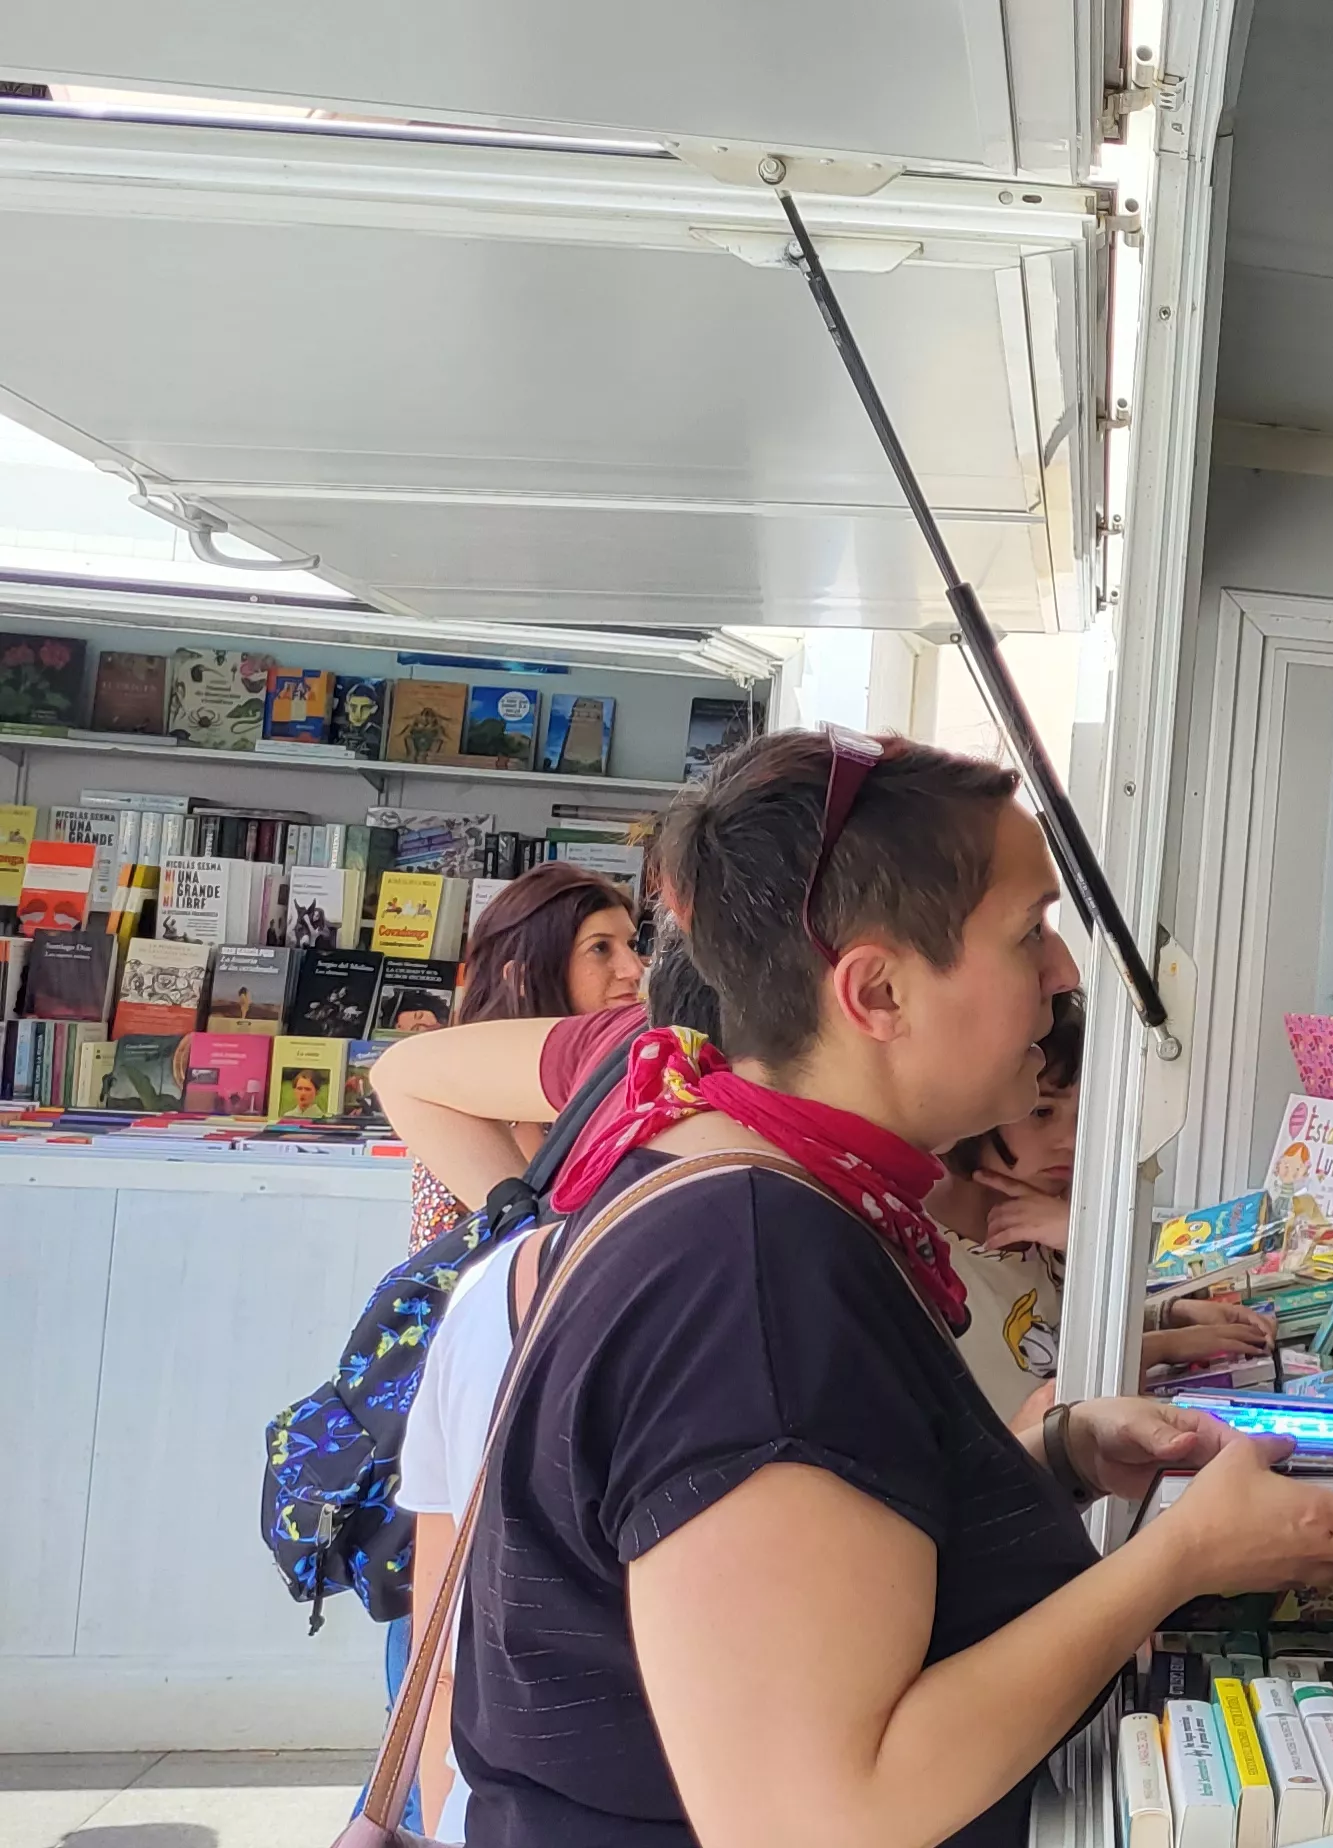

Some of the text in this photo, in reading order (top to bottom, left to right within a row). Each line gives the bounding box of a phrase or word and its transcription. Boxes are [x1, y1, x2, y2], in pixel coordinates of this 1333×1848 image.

[69, 820, 92, 832] UNA
[69, 831, 114, 846] GRANDE
[177, 871, 199, 884] UNA
[176, 884, 221, 899] GRANDE
[176, 897, 207, 910] LIBRE
